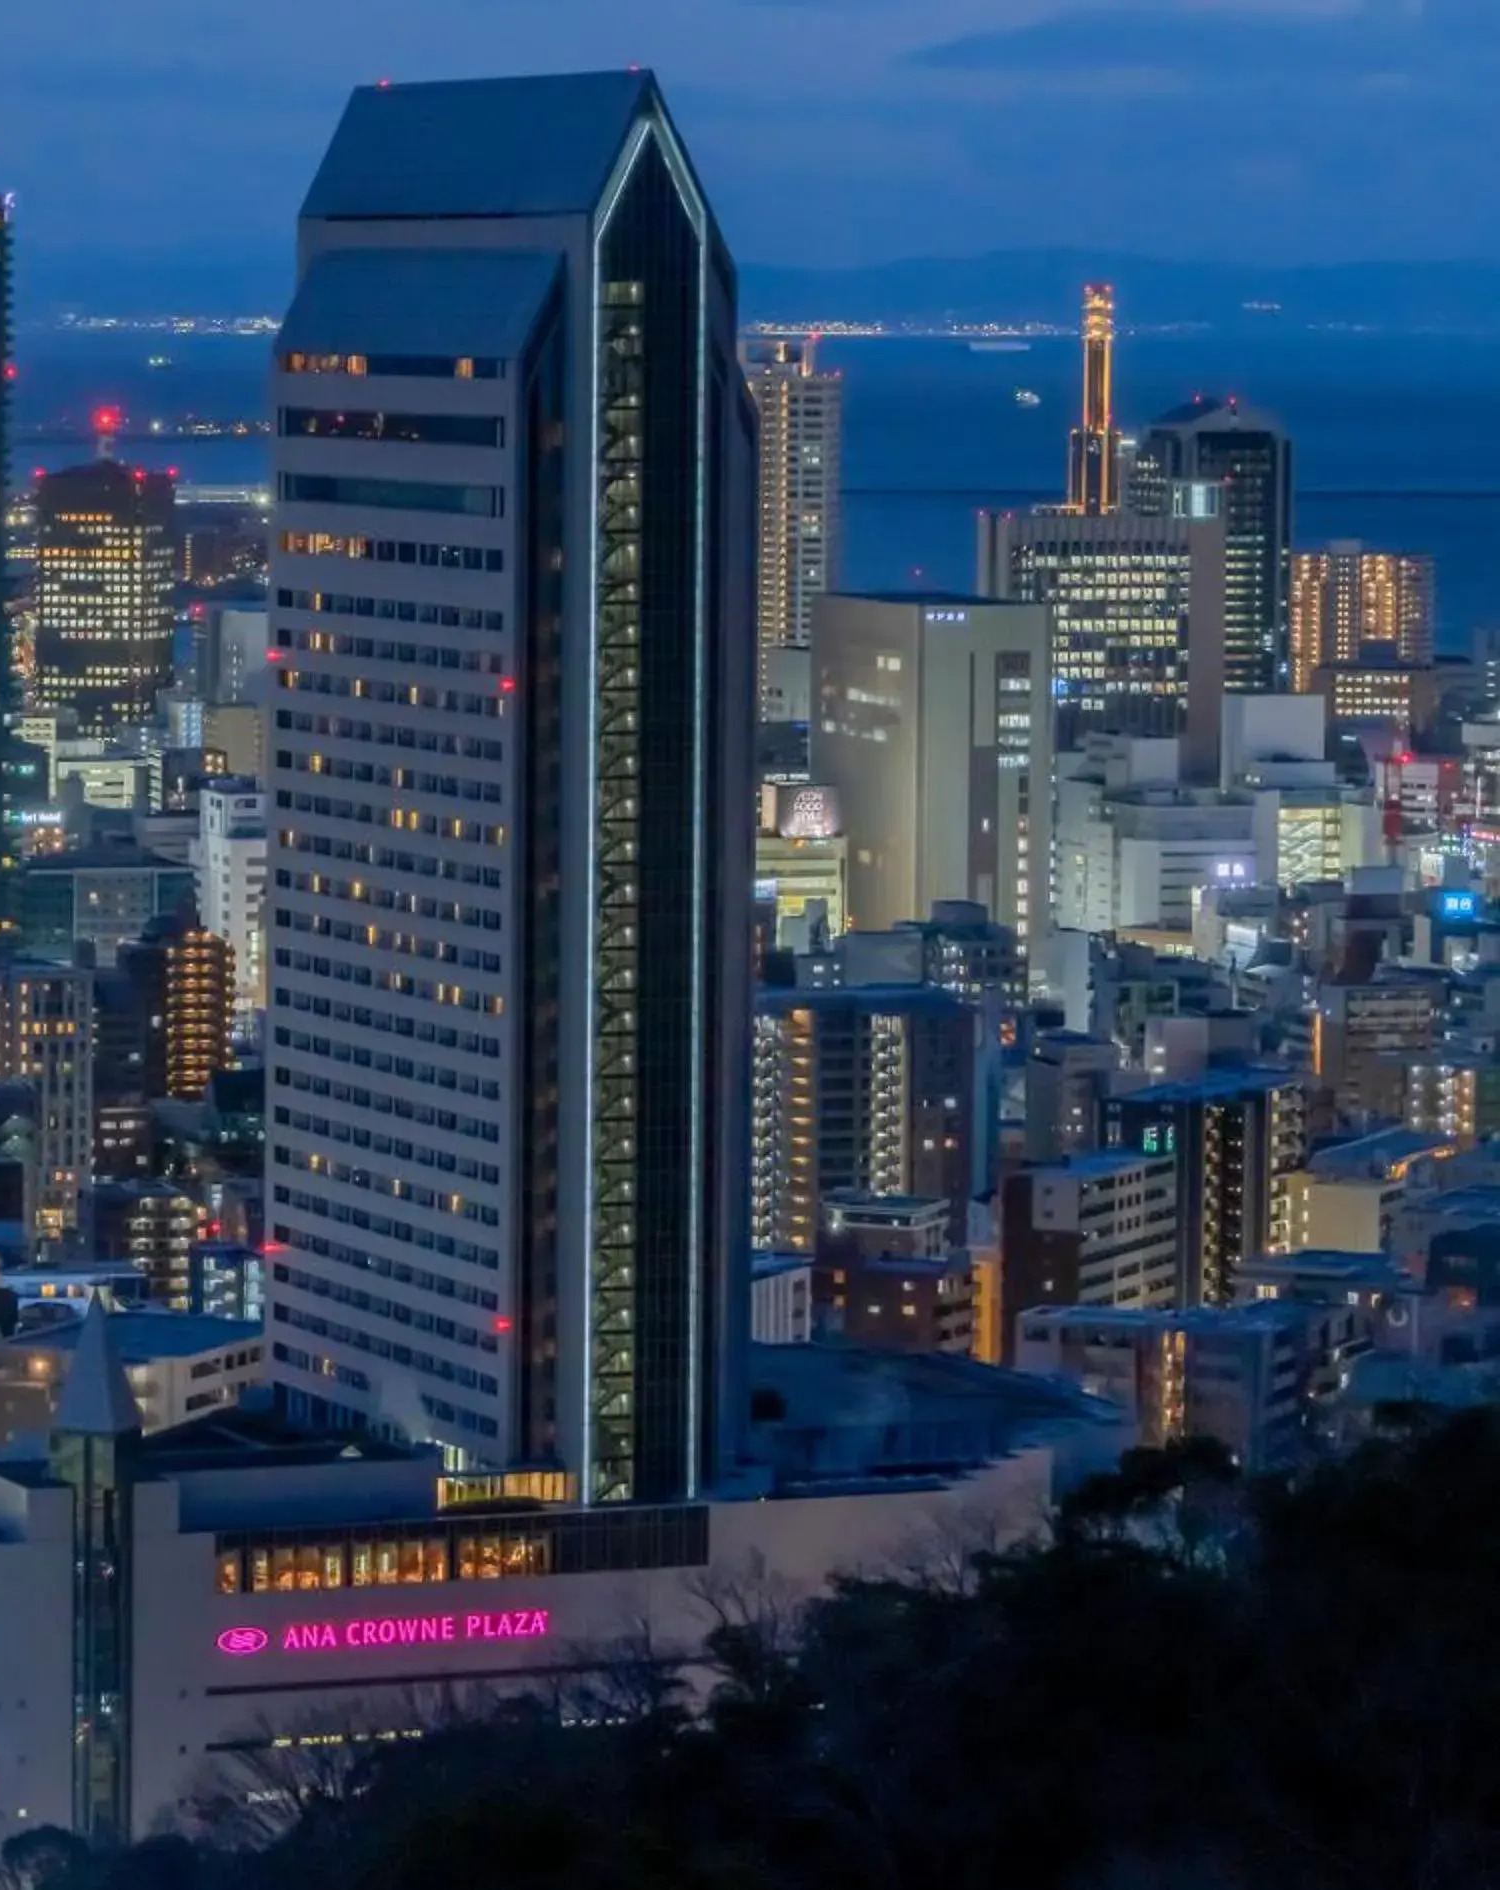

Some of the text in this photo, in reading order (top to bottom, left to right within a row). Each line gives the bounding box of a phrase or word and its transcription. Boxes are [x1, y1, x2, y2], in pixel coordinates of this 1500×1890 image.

[283, 1611, 547, 1649] ANA CROWNE PLAZA
